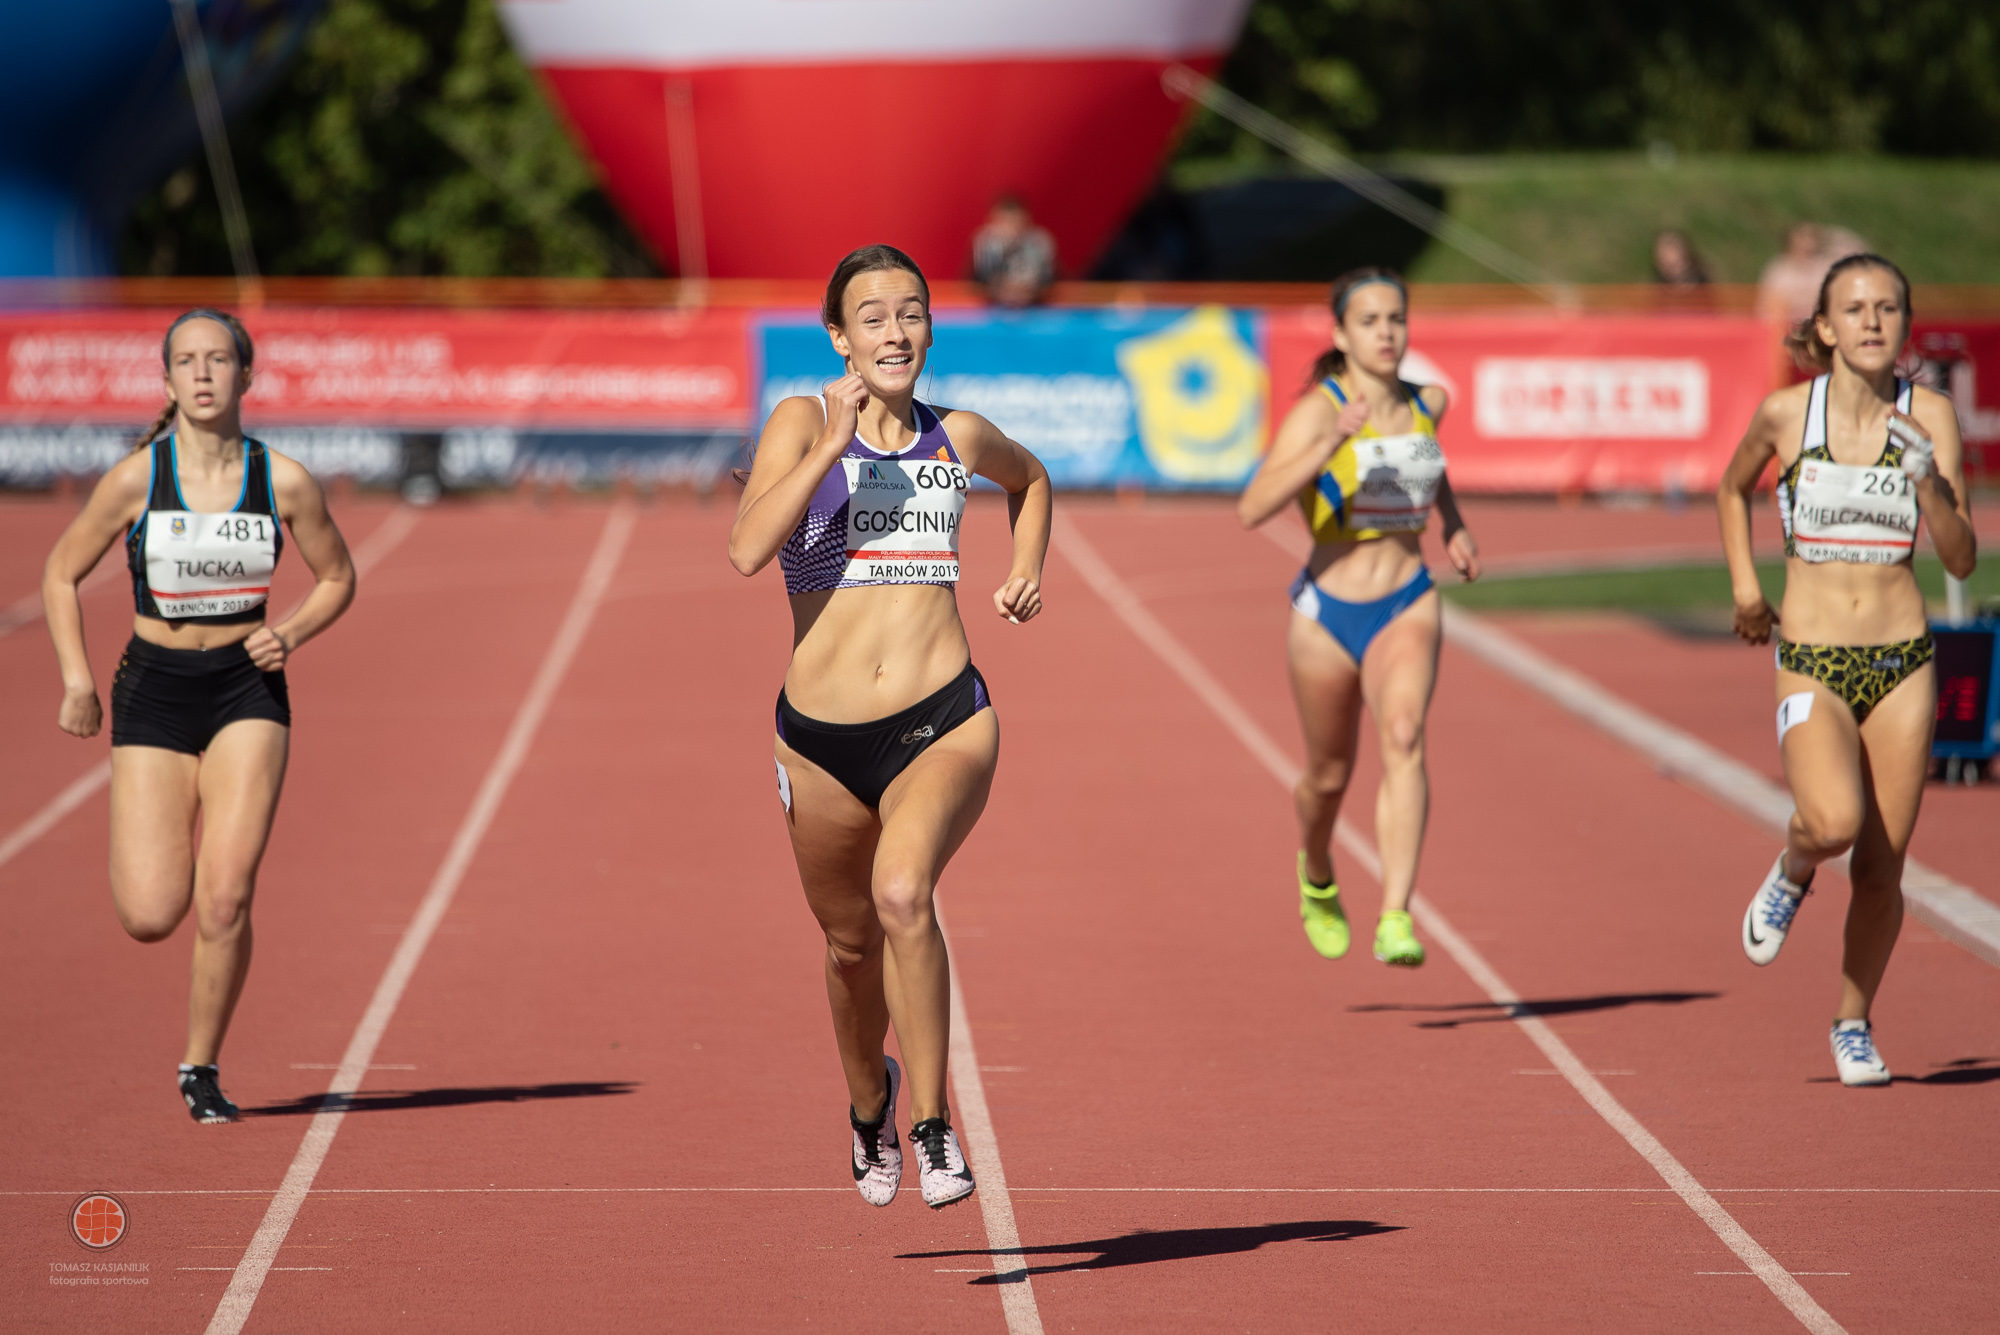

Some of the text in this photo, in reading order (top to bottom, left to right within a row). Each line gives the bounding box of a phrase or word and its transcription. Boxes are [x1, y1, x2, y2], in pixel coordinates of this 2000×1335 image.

[851, 481, 907, 491] MAŁOPOLSKA
[916, 465, 967, 490] 608
[1863, 472, 1910, 497] 261
[1797, 503, 1911, 532] MIELCZAREK
[216, 518, 268, 542] 481
[1808, 546, 1892, 563] TARNÓW 2019
[174, 558, 246, 579] TUCKA
[870, 562, 959, 577] TARNÓW 2019
[165, 599, 250, 614] TARNÓW 2019
[1781, 701, 1790, 727] 1
